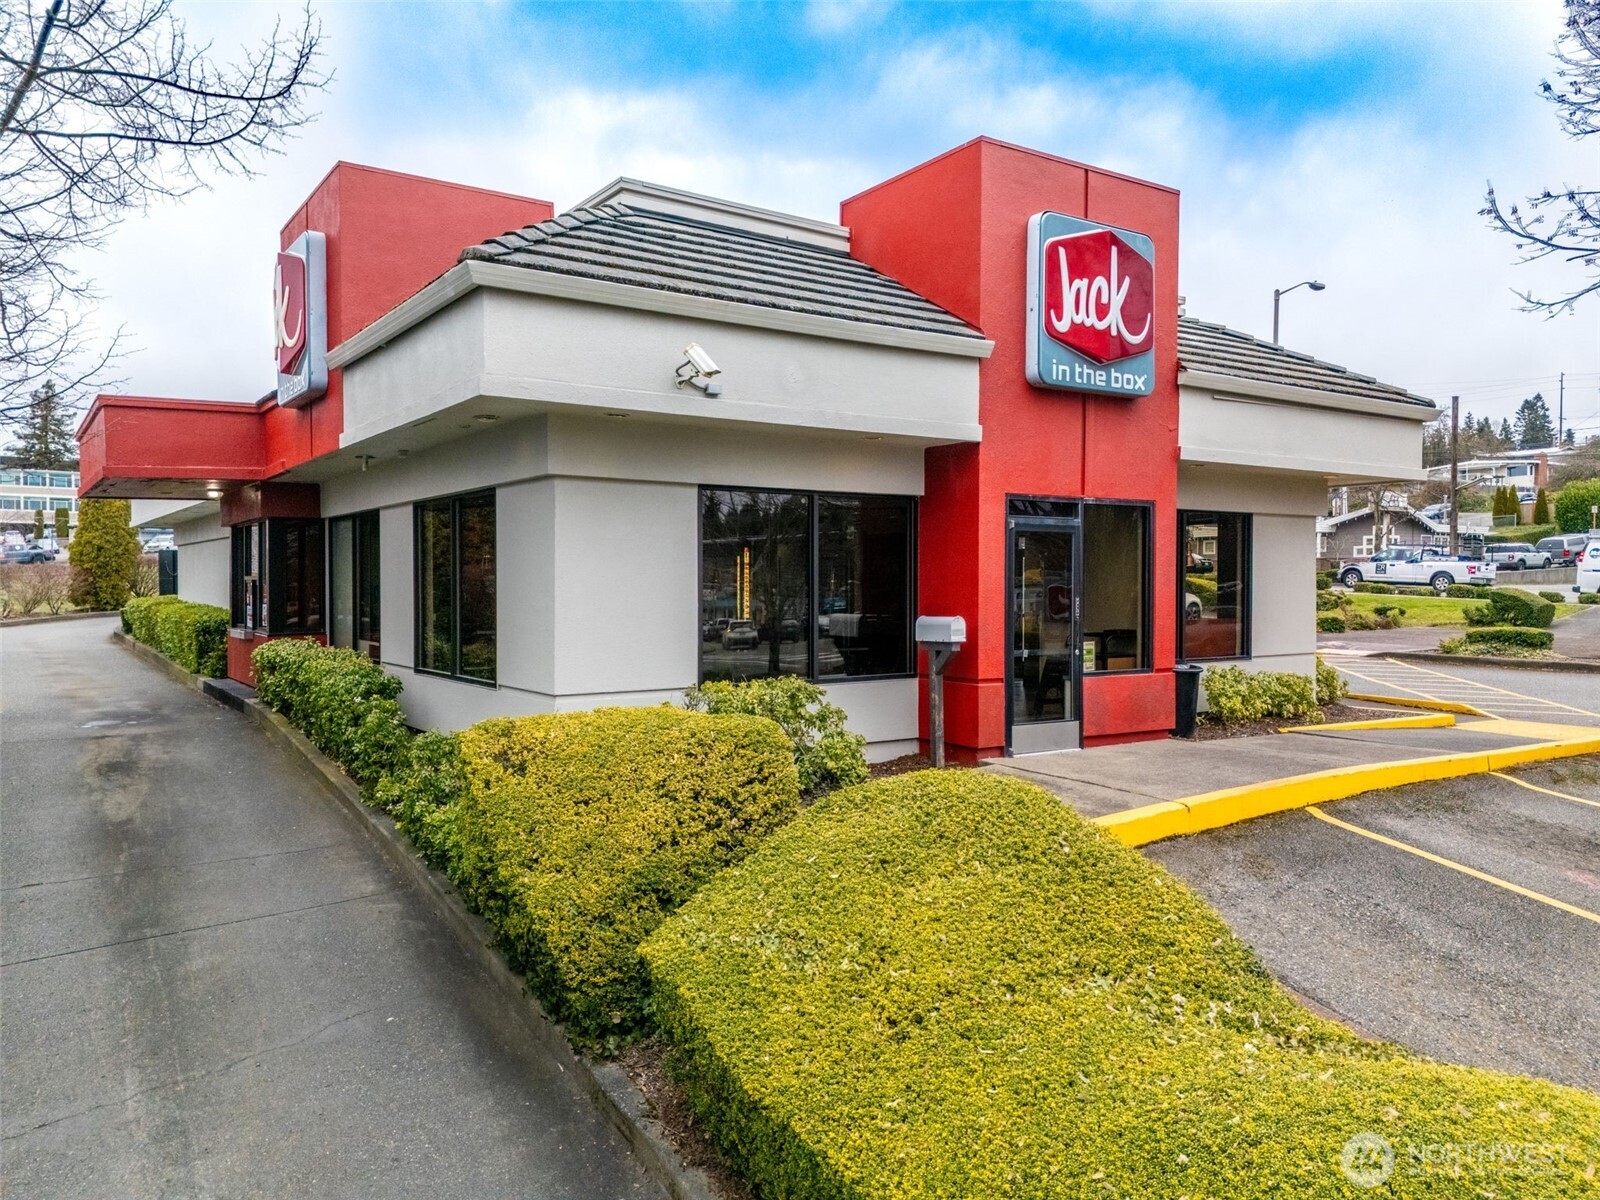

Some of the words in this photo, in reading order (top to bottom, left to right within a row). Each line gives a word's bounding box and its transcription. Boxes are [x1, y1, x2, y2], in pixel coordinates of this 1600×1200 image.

[1050, 245, 1151, 345] Jack
[1052, 359, 1070, 382] in
[1075, 362, 1106, 387] the
[1111, 368, 1146, 391] box
